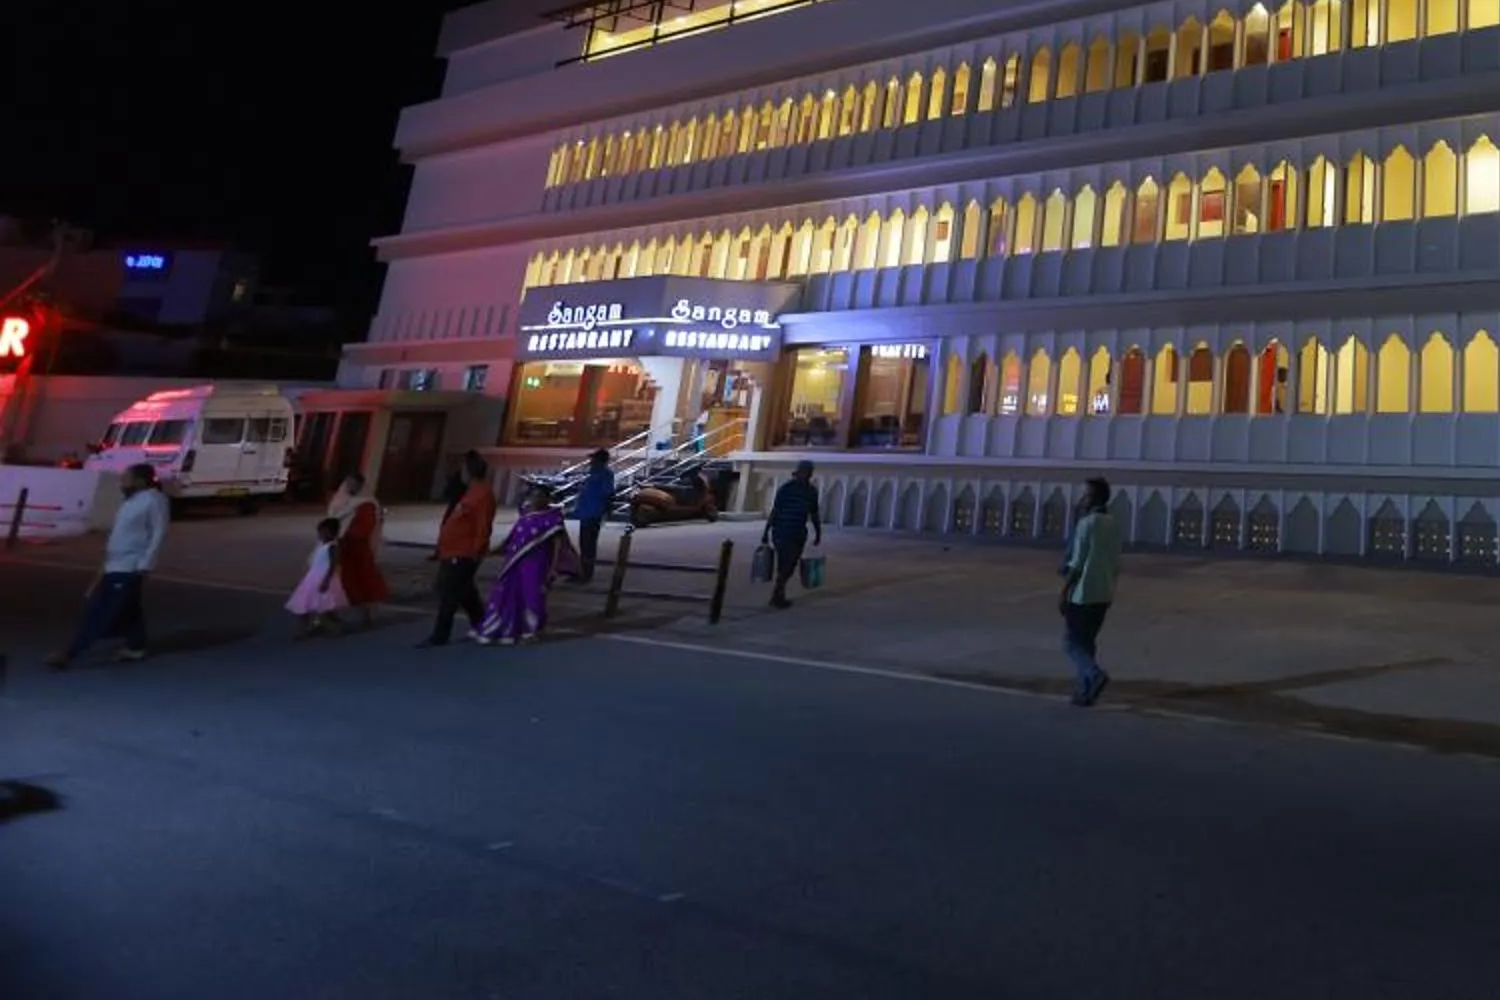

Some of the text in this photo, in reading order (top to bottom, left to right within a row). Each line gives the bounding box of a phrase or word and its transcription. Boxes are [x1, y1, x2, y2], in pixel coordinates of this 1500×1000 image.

[547, 300, 622, 331] Sangam
[671, 299, 769, 329] Sangam
[527, 329, 633, 352] RESTAURANT
[664, 330, 772, 351] RESTAURANT
